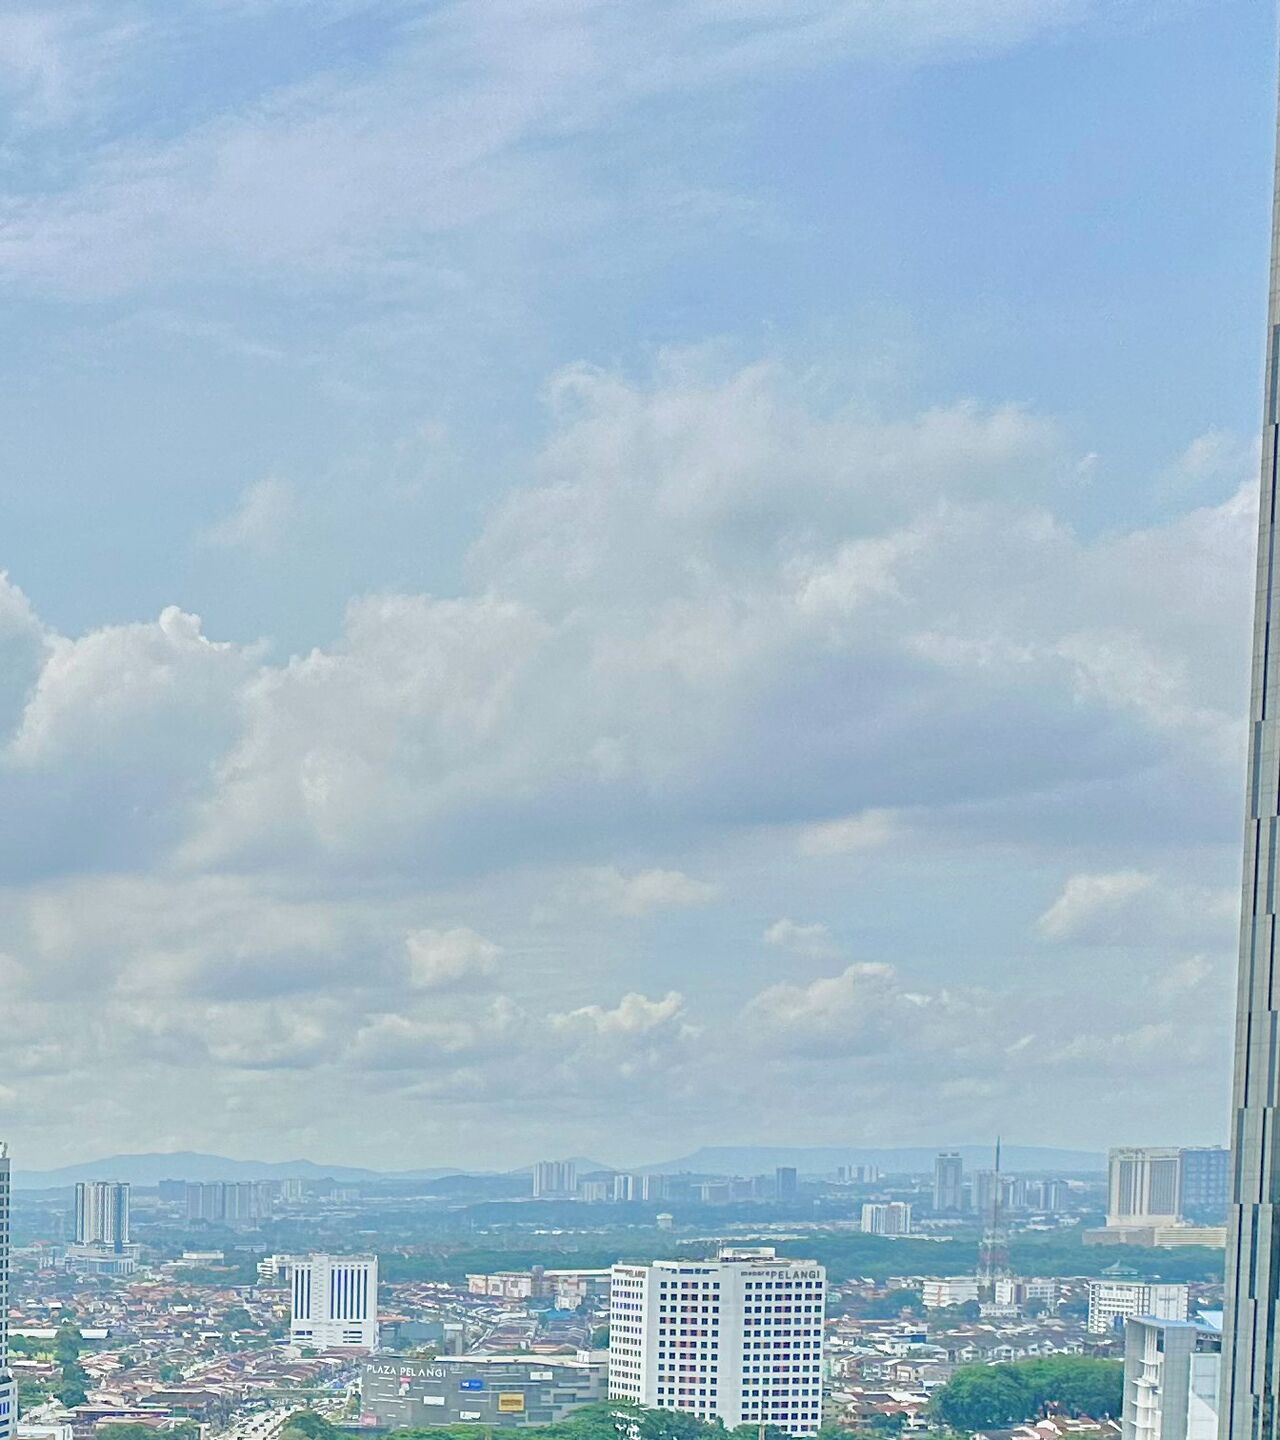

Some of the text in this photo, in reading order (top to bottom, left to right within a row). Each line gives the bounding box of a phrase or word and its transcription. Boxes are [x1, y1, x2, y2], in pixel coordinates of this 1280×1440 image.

[770, 1270, 820, 1280] PELANGI
[366, 1364, 447, 1378] PLAZA PELANGI
